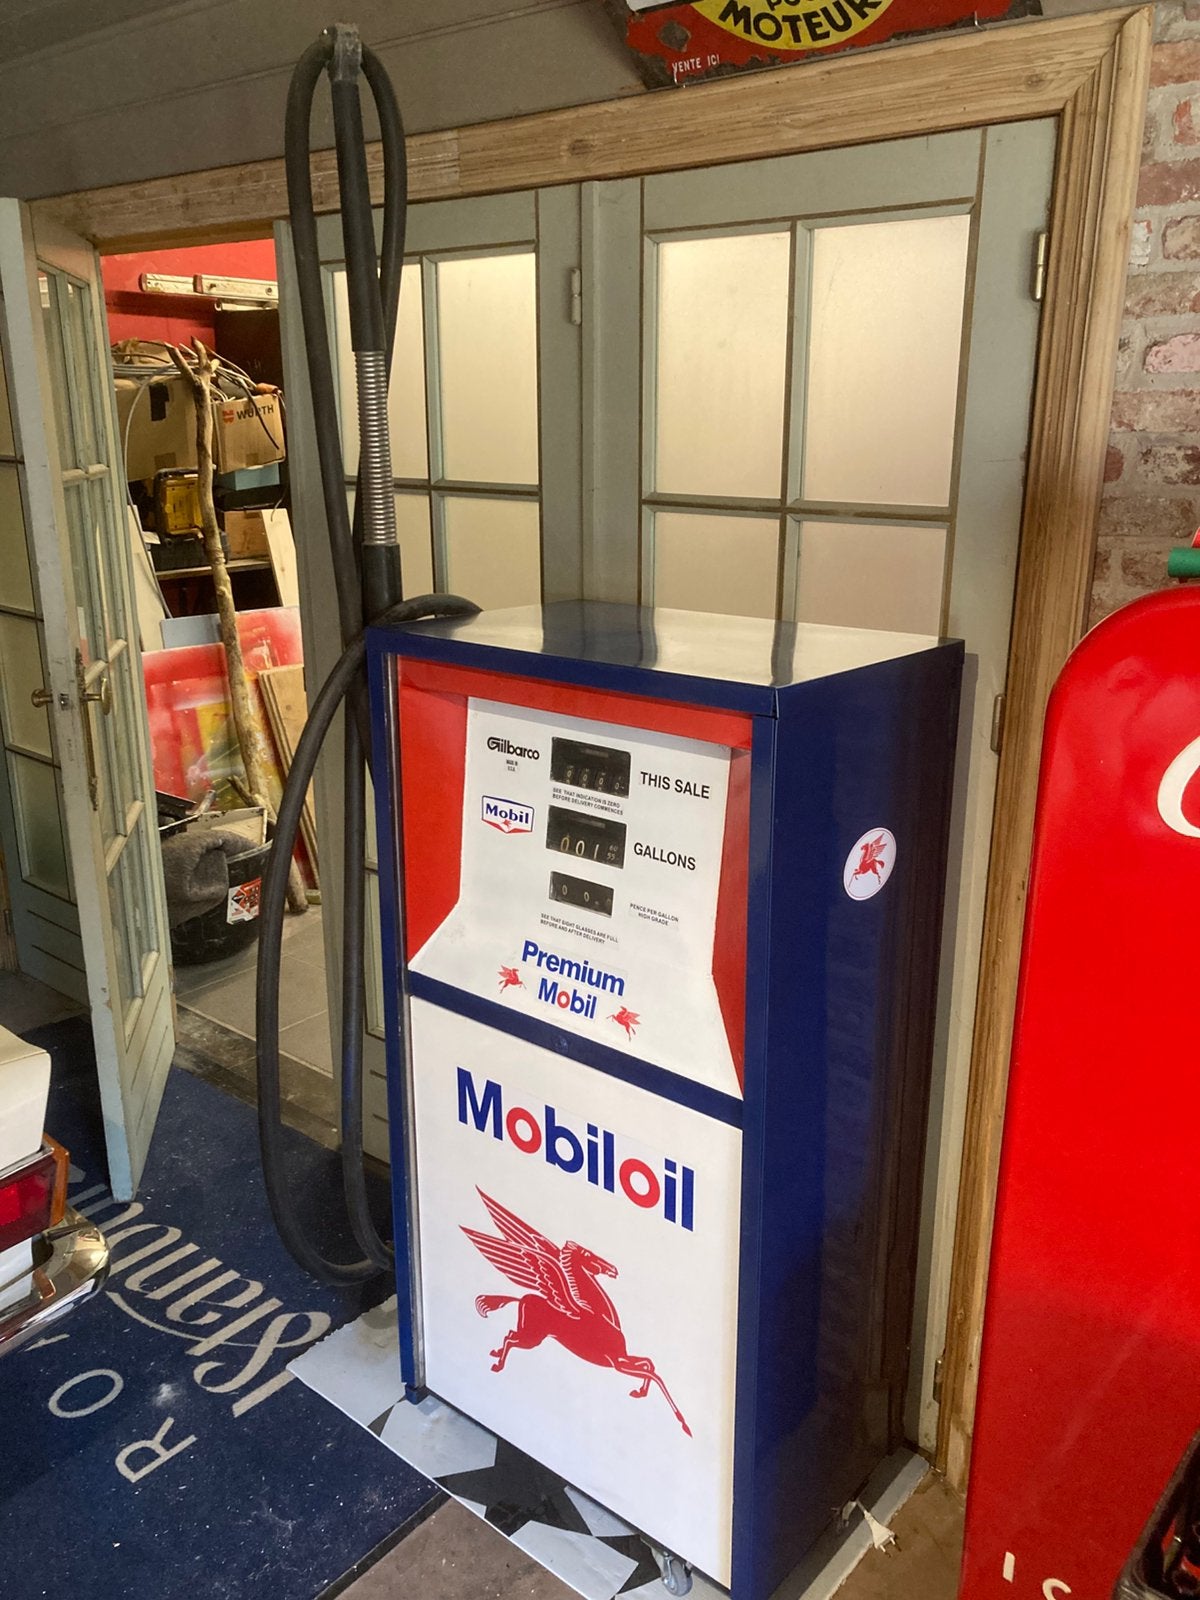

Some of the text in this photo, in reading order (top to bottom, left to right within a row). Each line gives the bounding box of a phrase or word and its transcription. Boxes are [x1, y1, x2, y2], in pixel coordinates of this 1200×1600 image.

[672, 54, 720, 73] VENTE ICI
[487, 736, 541, 760] Gilbarco
[640, 771, 710, 799] THIS SALE
[552, 793, 624, 815] BEFORE DELIVERY COMMENCES
[576, 793, 602, 804] INDICATION
[607, 800, 621, 808] ZERO
[485, 803, 530, 825] Mobil
[634, 842, 696, 871] GALLONS
[630, 902, 646, 913] PENCE
[658, 911, 679, 922] GALLON
[651, 915, 668, 926] GRADE
[540, 919, 606, 945] BEFORE AND AFTER DELIVERY
[550, 916, 562, 924] THAT
[562, 919, 575, 928] SIGHT
[575, 924, 596, 935] GLASSES
[597, 931, 606, 939] ARE
[606, 934, 619, 944] FULL
[522, 939, 625, 996] Premium
[538, 977, 597, 1019] Mobil
[456, 1066, 695, 1232] Mobiloil
